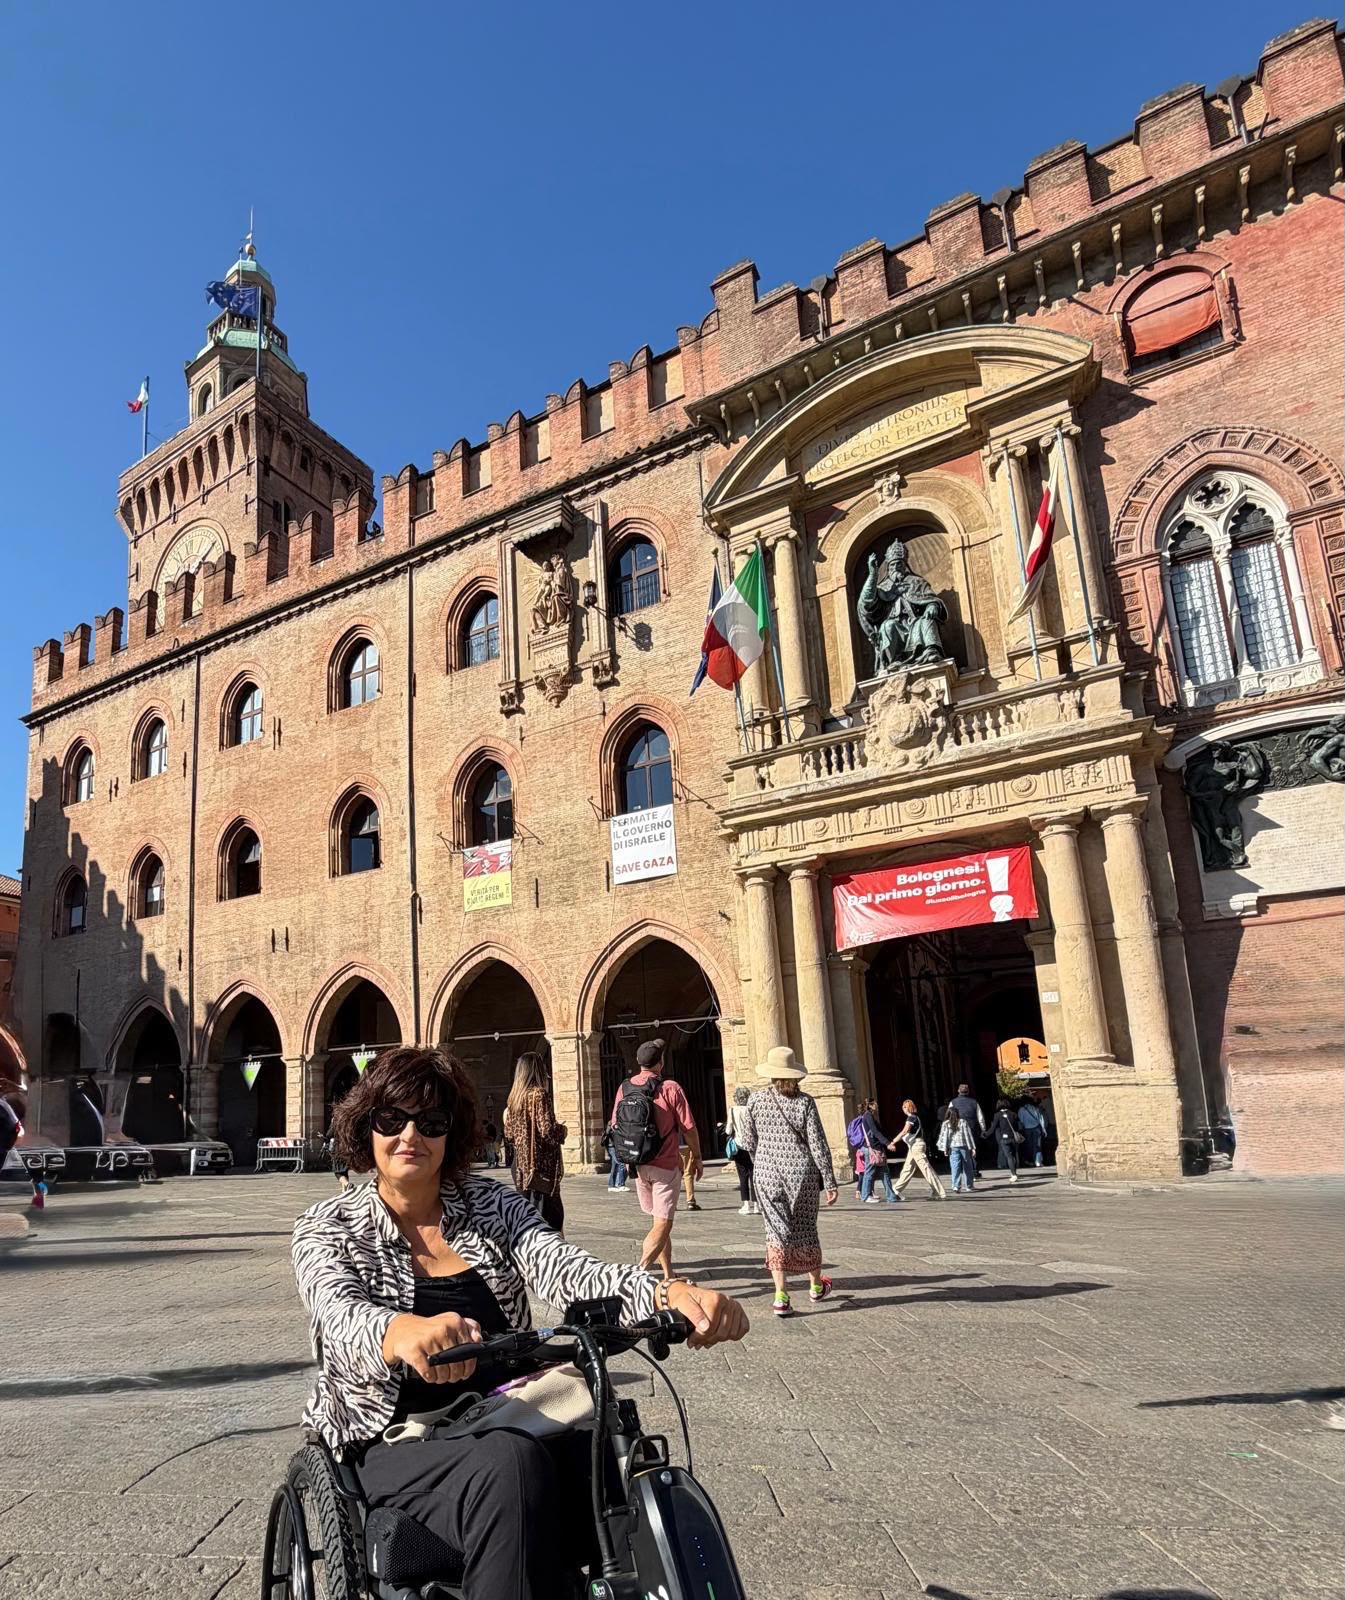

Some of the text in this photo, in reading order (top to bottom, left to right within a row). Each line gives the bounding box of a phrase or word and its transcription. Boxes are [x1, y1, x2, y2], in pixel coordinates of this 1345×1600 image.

[916, 406, 964, 432] PATER
[612, 811, 658, 828] FERMATE
[613, 819, 672, 841] IL GOVERNO
[613, 832, 666, 851] DI ISRAELE
[615, 855, 674, 875] SAVE GAZA
[896, 862, 985, 886] Bolognesi.
[848, 878, 985, 906] Dal primo giorno.
